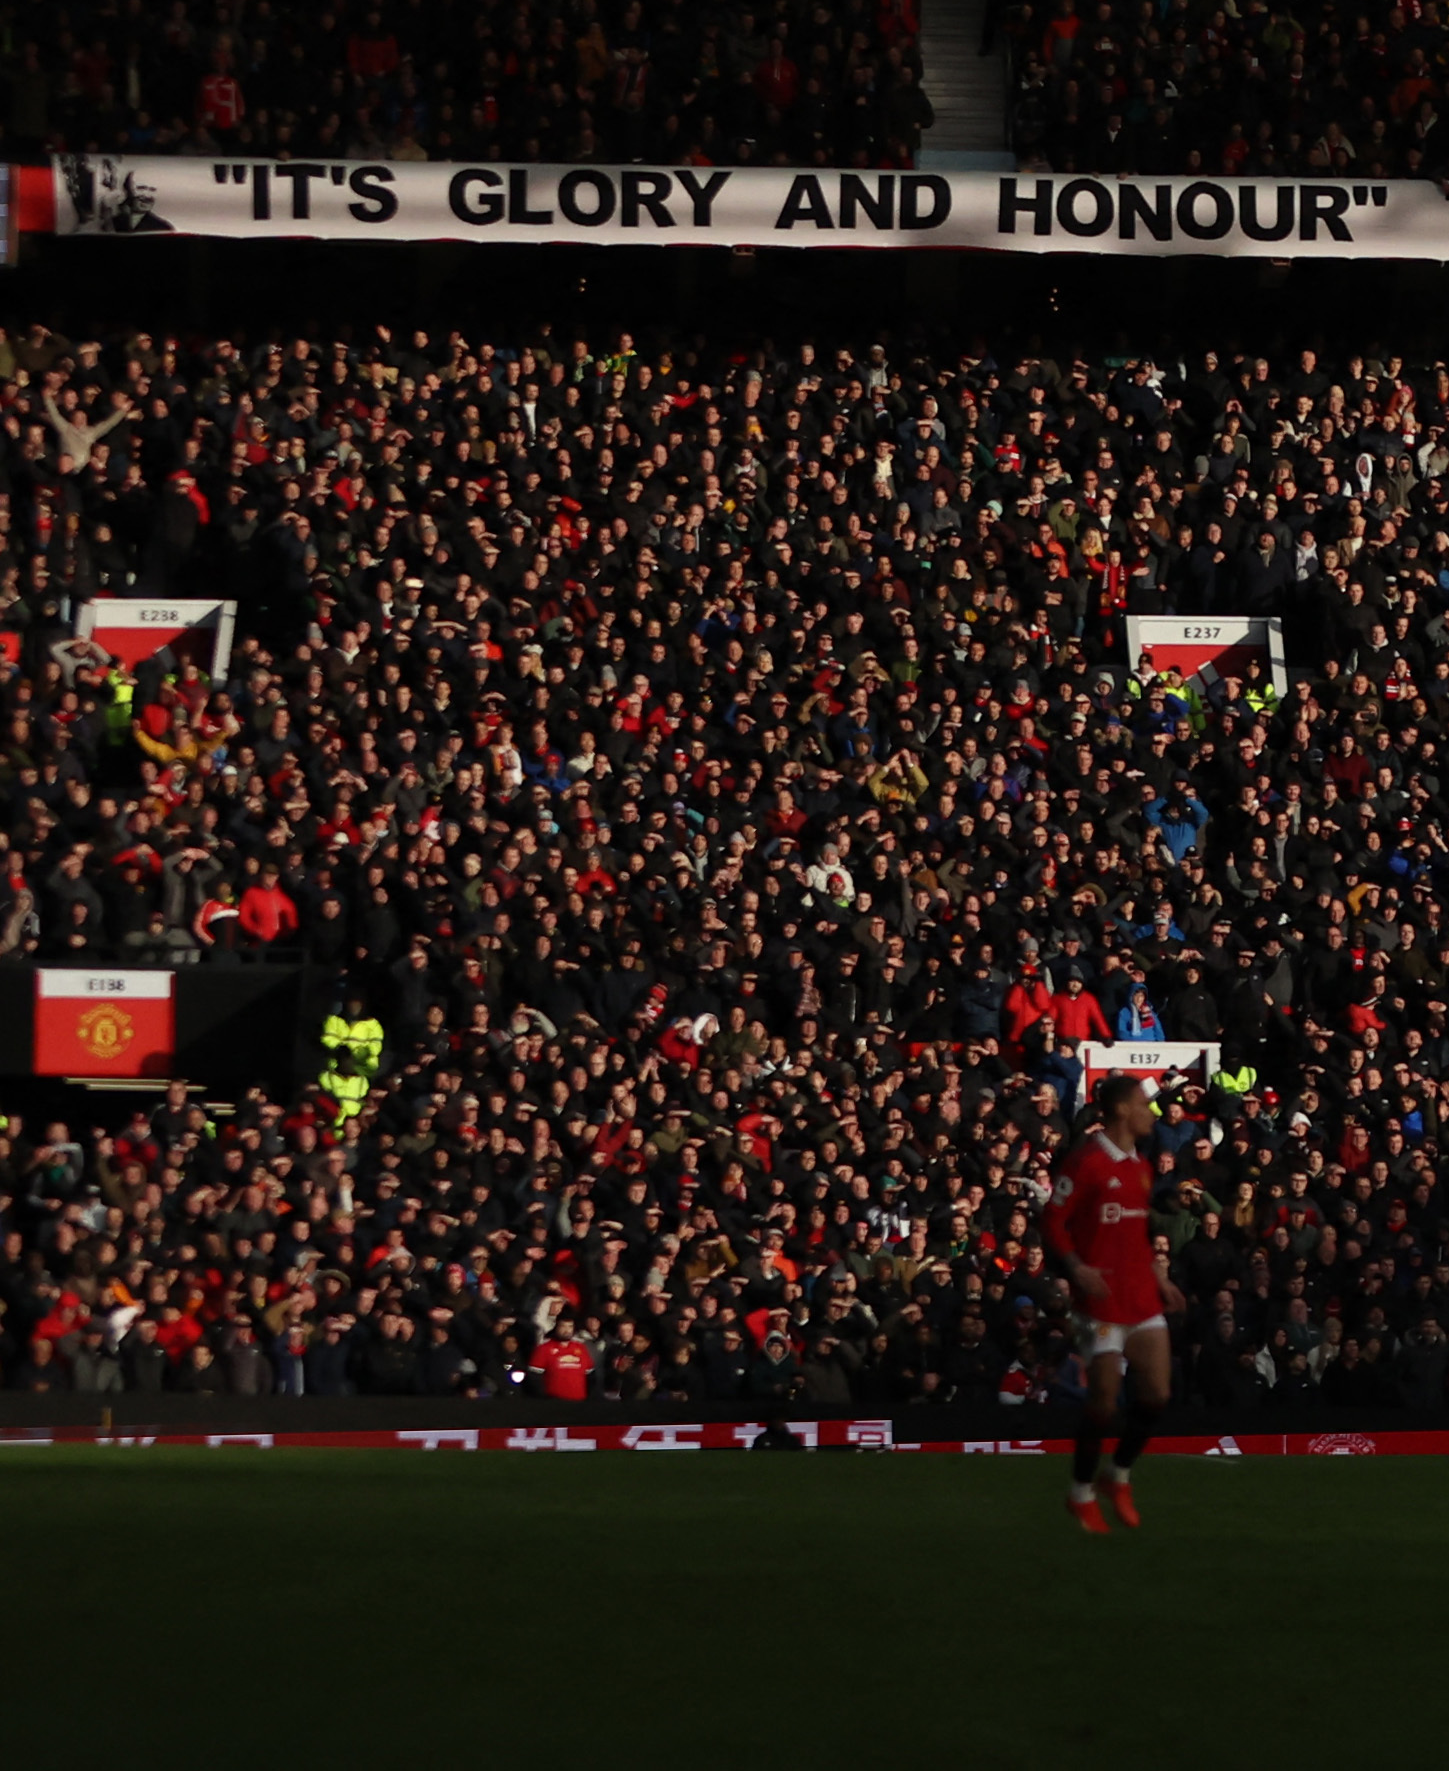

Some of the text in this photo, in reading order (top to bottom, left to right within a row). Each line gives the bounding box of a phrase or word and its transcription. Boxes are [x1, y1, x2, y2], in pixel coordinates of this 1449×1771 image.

[212, 163, 398, 224] "IT'S
[448, 169, 733, 229] GLORY
[775, 174, 952, 230] AND
[998, 178, 1388, 244] HONOUR"
[140, 609, 179, 622] E238
[1184, 627, 1221, 639] E237
[1129, 1053, 1161, 1065] E137
